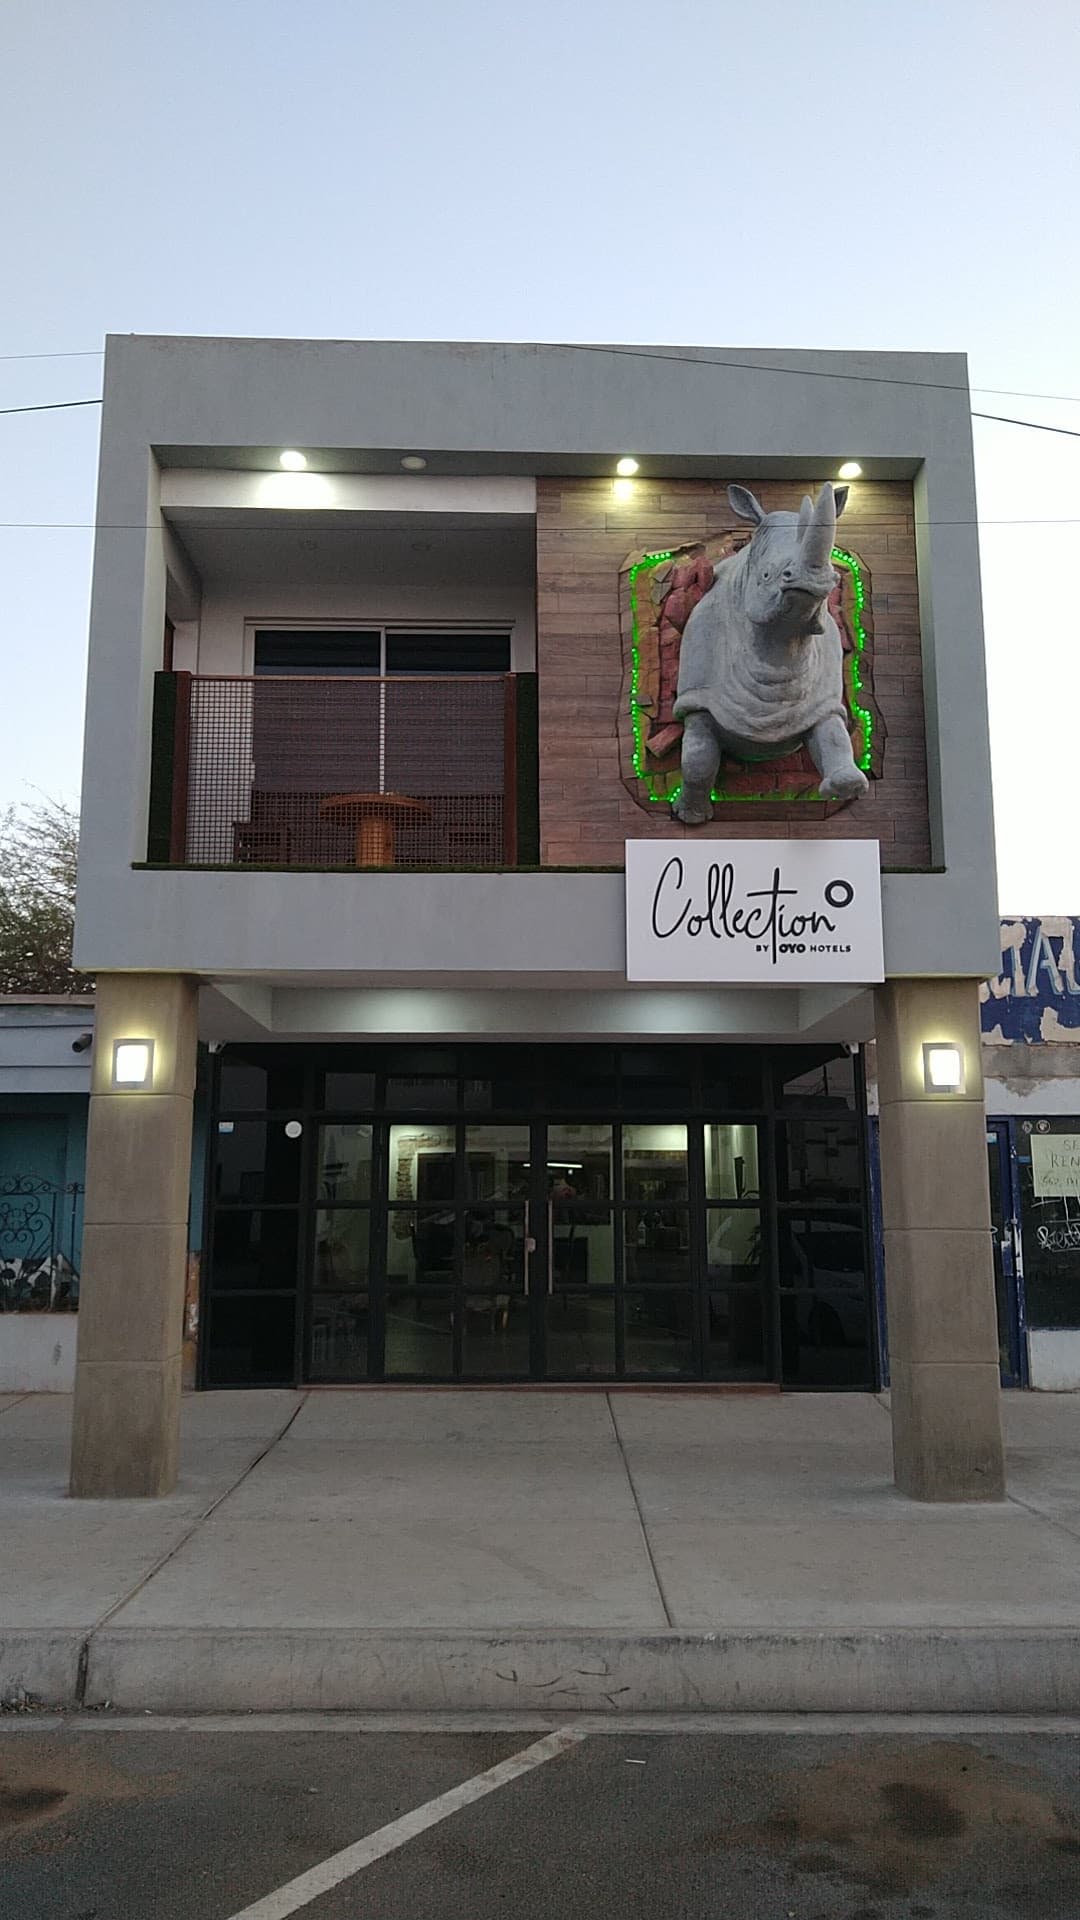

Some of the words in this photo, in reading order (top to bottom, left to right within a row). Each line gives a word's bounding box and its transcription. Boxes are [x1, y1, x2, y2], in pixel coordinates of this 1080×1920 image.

[652, 857, 836, 965] Collection
[756, 944, 769, 953] BY
[778, 943, 806, 954] OYO
[810, 944, 852, 953] HOTELS
